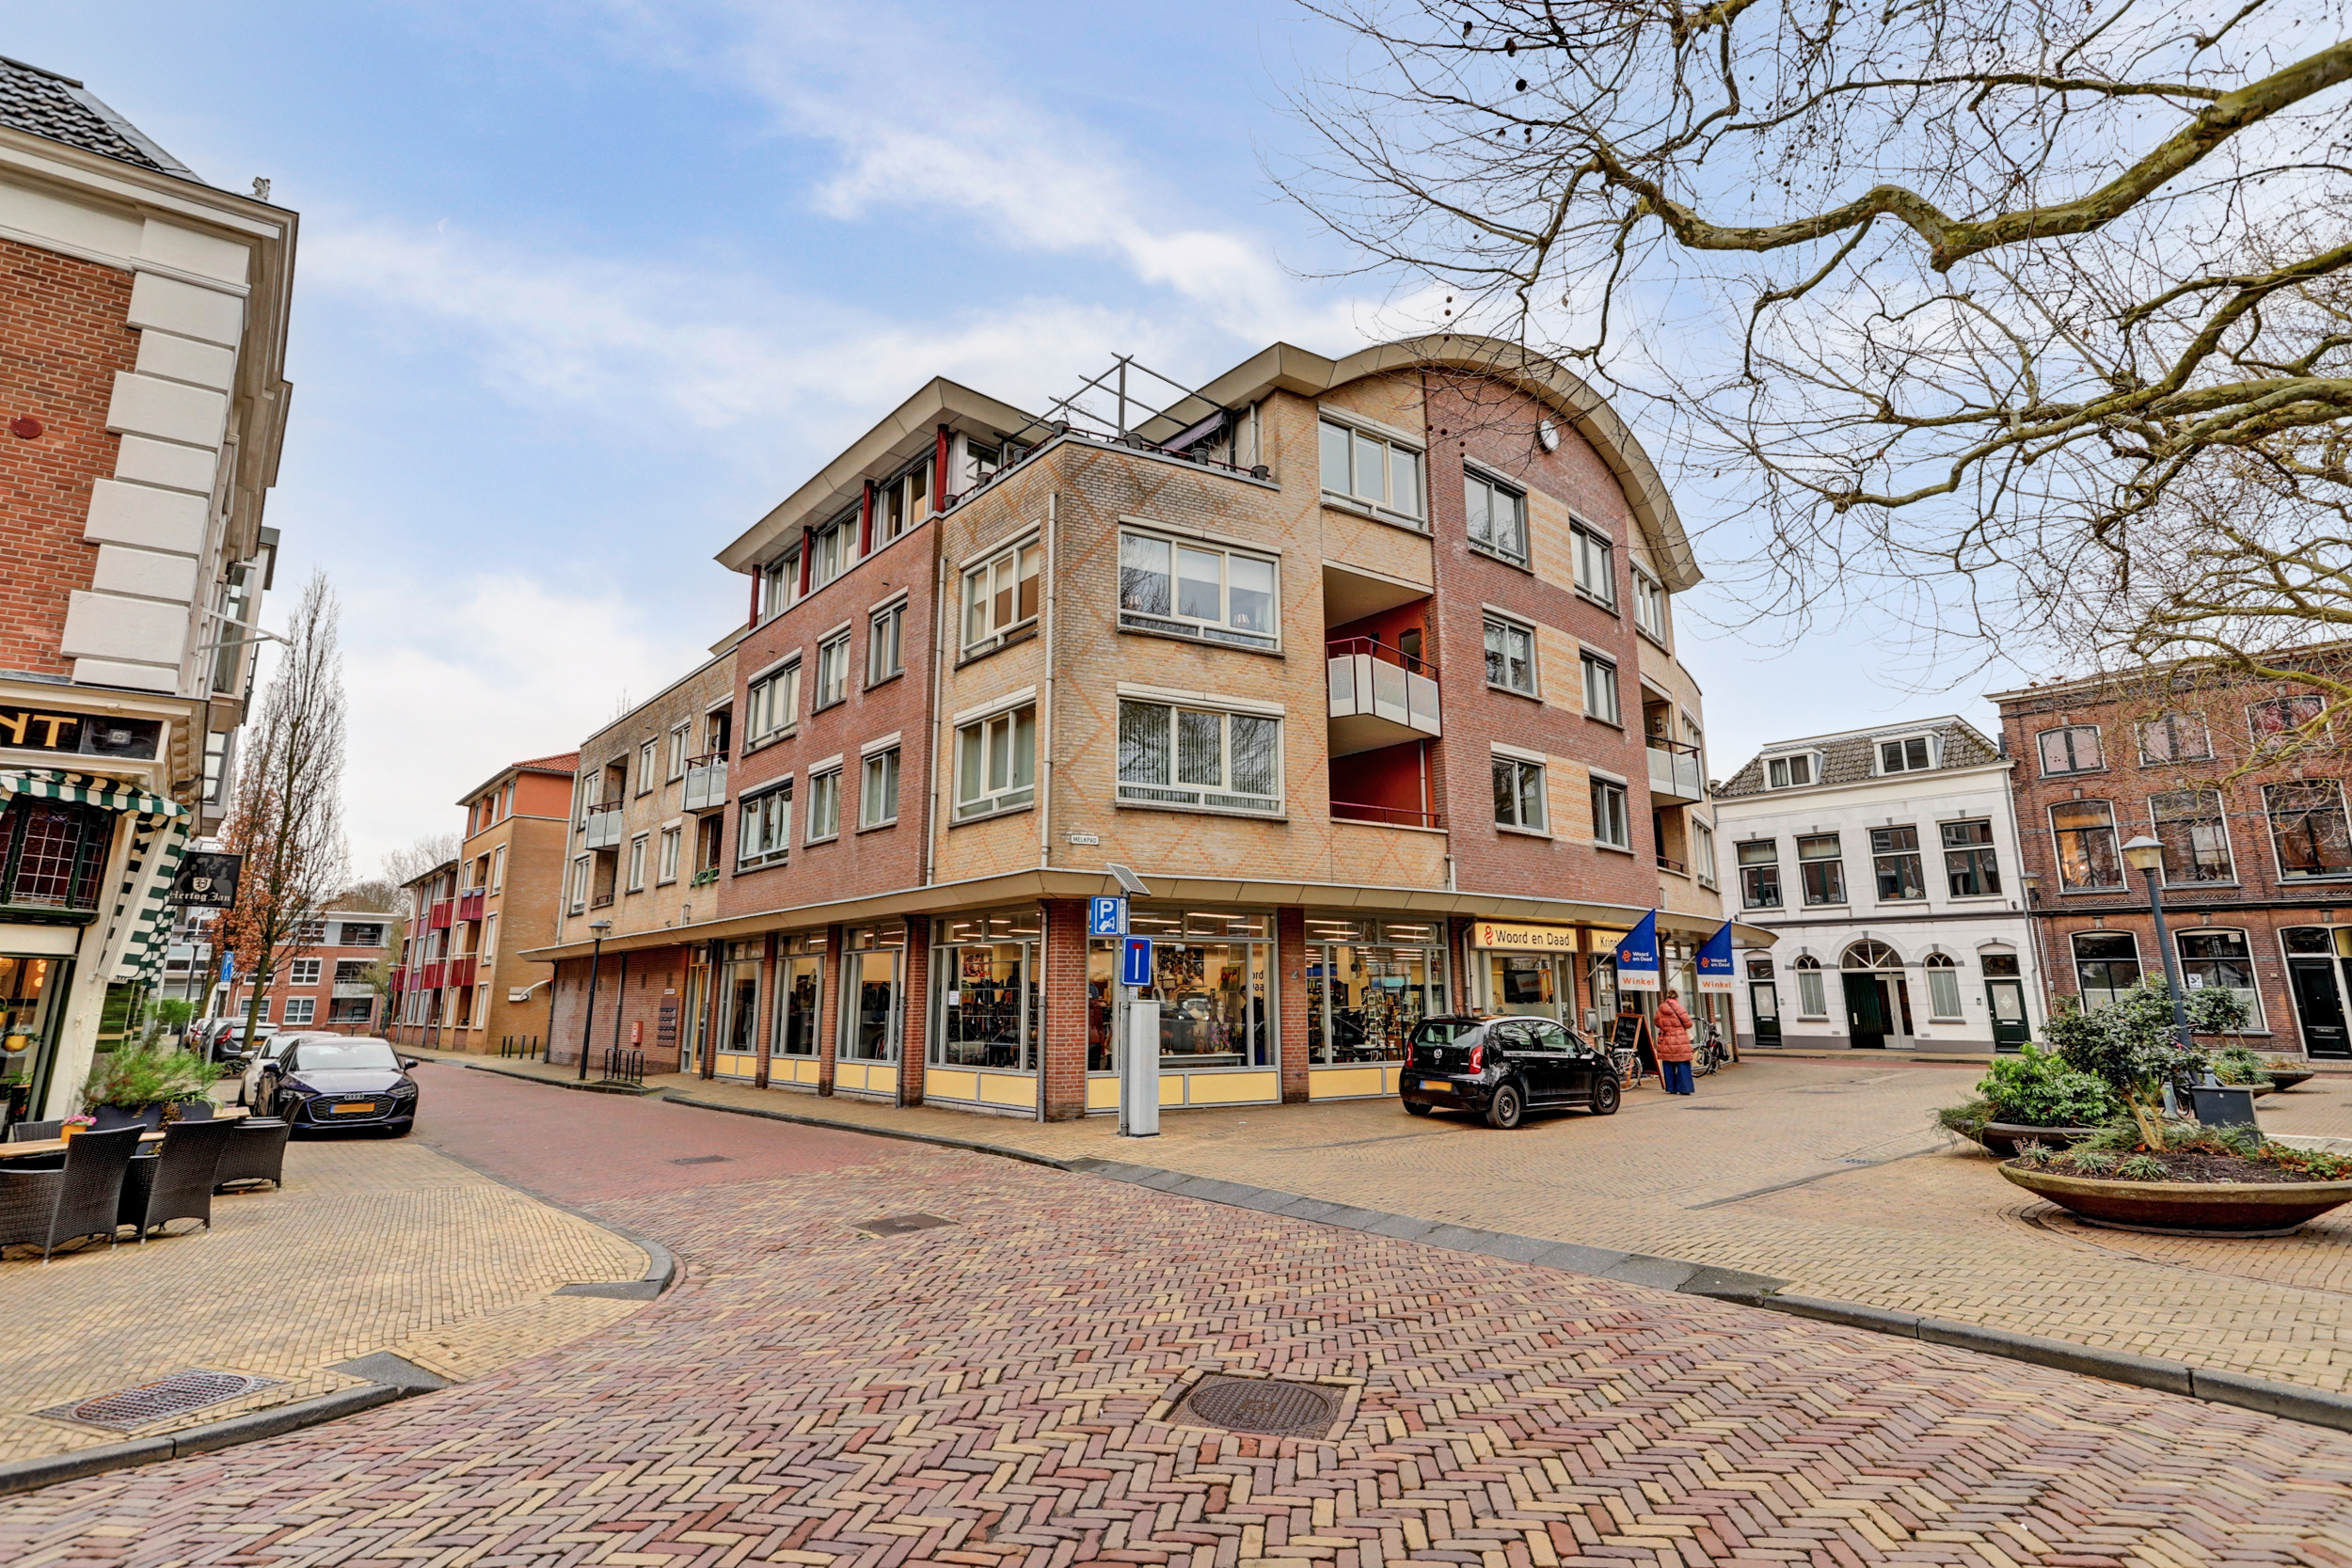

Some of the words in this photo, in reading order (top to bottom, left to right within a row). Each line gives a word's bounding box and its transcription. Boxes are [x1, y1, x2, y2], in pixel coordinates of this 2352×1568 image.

[169, 890, 208, 902] Hertog
[208, 892, 230, 902] Jan
[1100, 900, 1114, 919] P
[1495, 929, 1528, 944] Woord
[1532, 934, 1543, 944] en
[1547, 932, 1570, 946] Daad
[1622, 977, 1655, 986] Winkel
